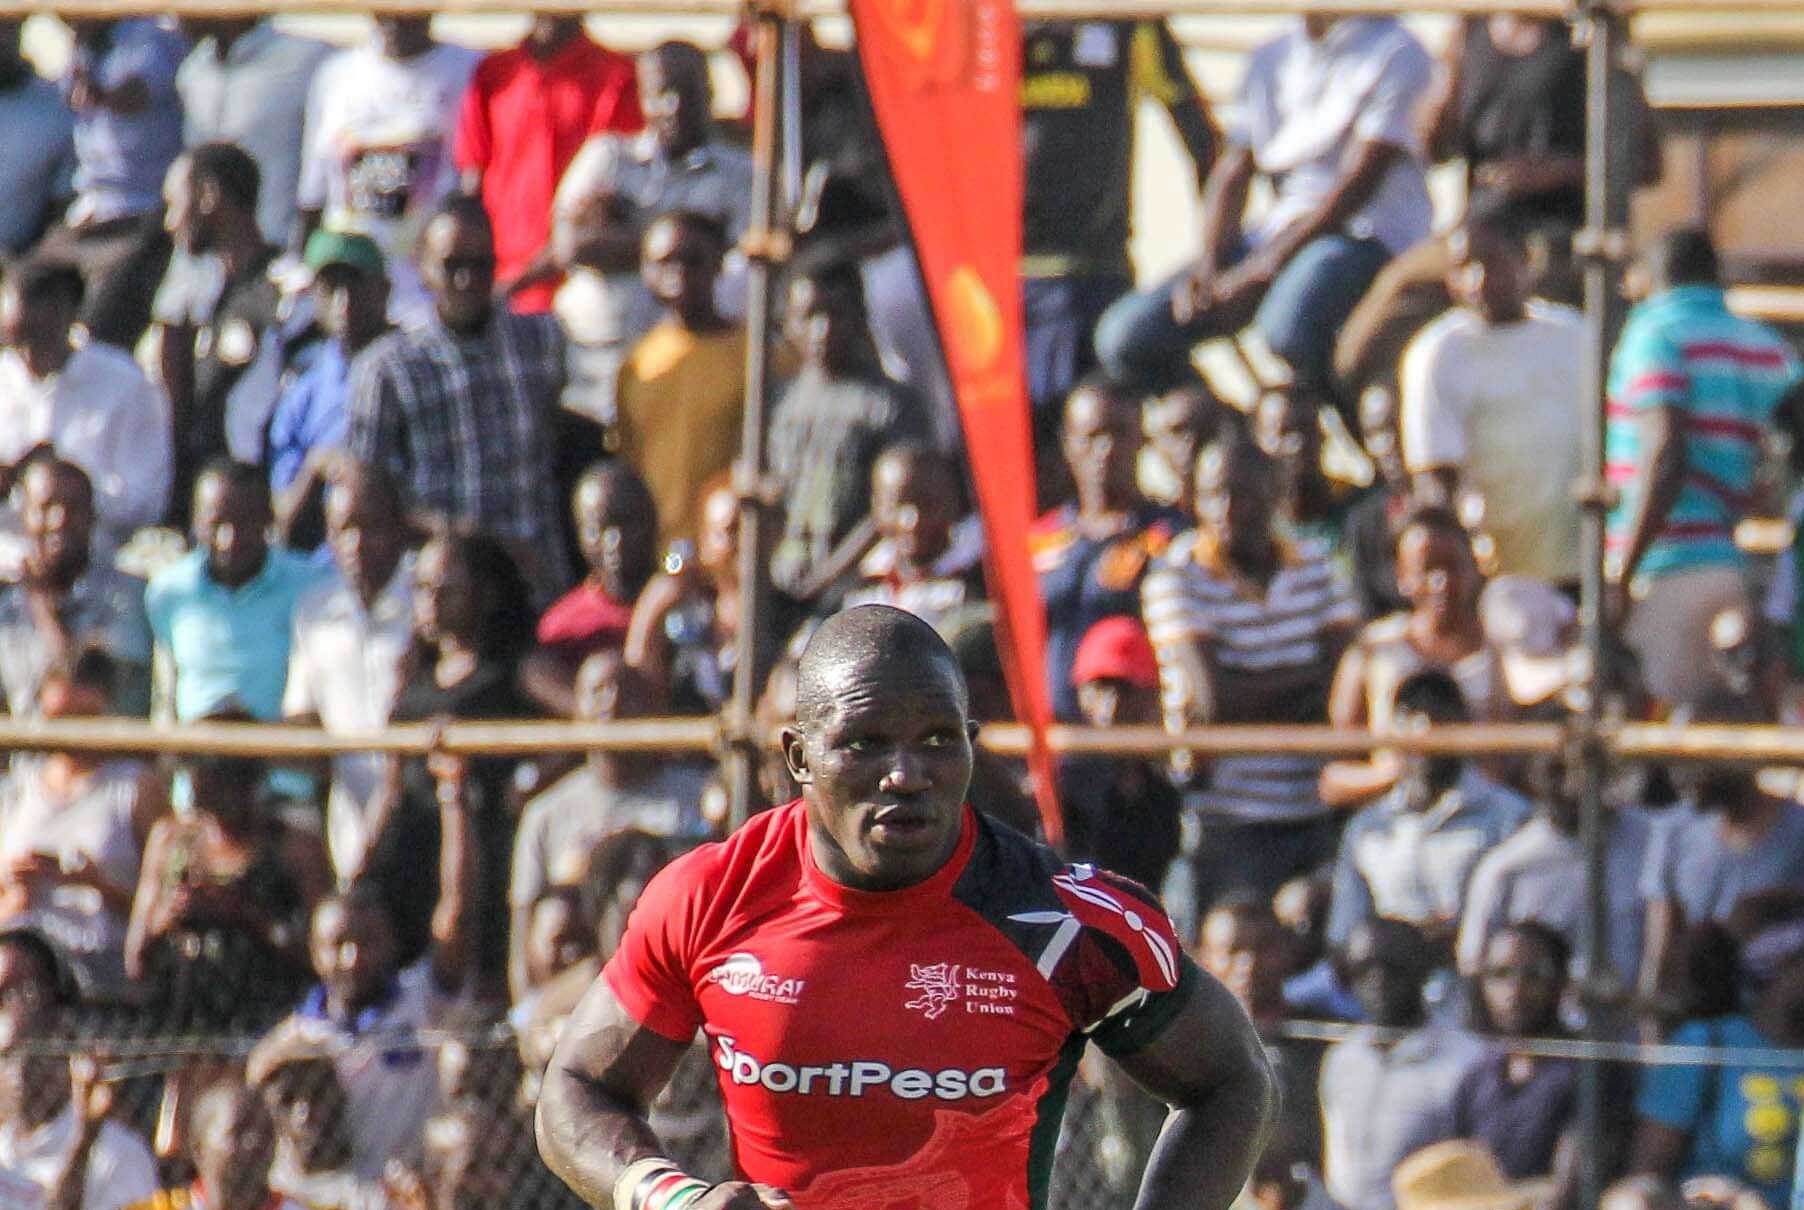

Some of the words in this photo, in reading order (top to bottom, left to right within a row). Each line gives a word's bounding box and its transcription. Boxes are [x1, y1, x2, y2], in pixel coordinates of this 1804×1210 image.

[966, 967, 1016, 984] Kenya
[966, 984, 1018, 1001] Rugby
[966, 1001, 1014, 1015] Union
[716, 1034, 1007, 1100] SportPesa
